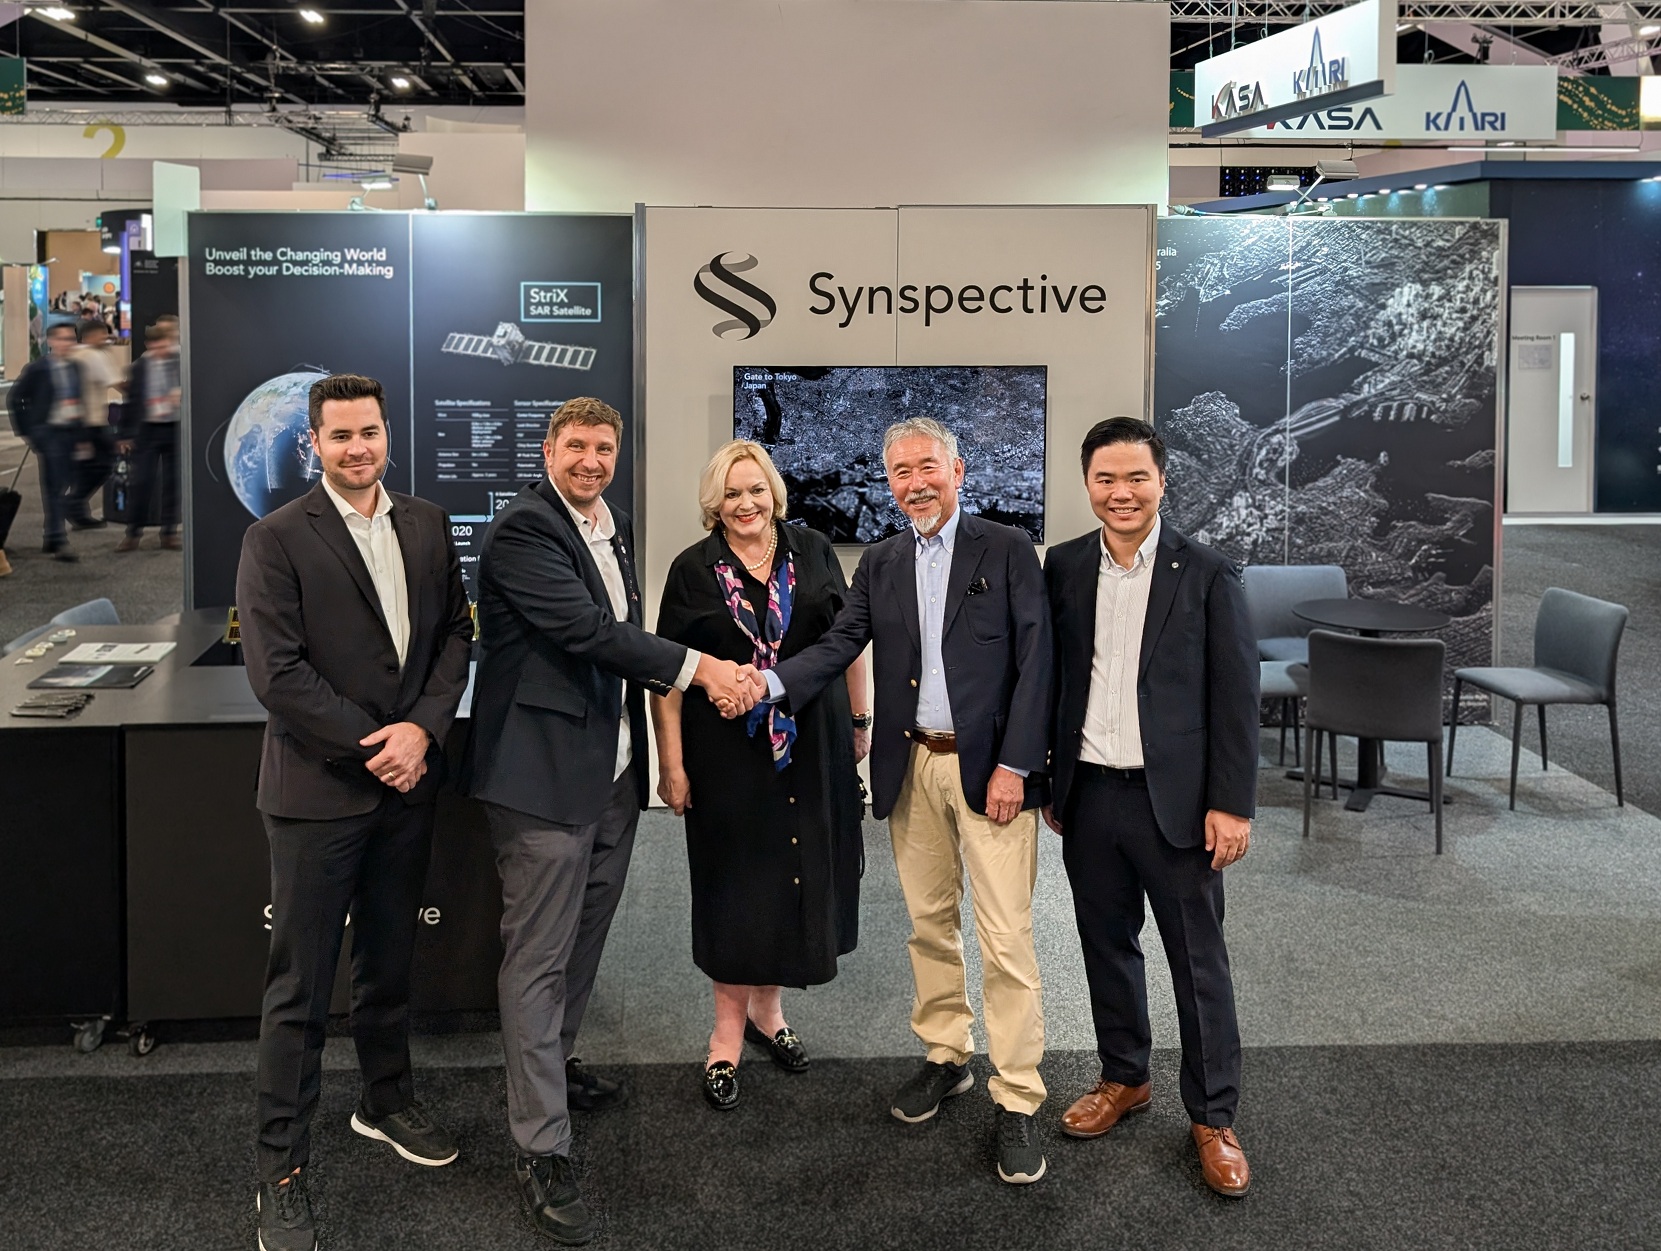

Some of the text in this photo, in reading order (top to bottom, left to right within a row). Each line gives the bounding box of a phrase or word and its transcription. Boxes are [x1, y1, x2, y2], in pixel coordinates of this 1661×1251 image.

[205, 247, 386, 264] Unveil the Changing World
[205, 262, 394, 279] Boost your Decision-Making
[529, 288, 569, 303] StriX
[808, 271, 1107, 329] Synspective
[529, 305, 592, 316] SAR Satellite
[774, 373, 797, 382] Tokyo
[744, 382, 767, 391] Japan
[451, 525, 473, 536] 020
